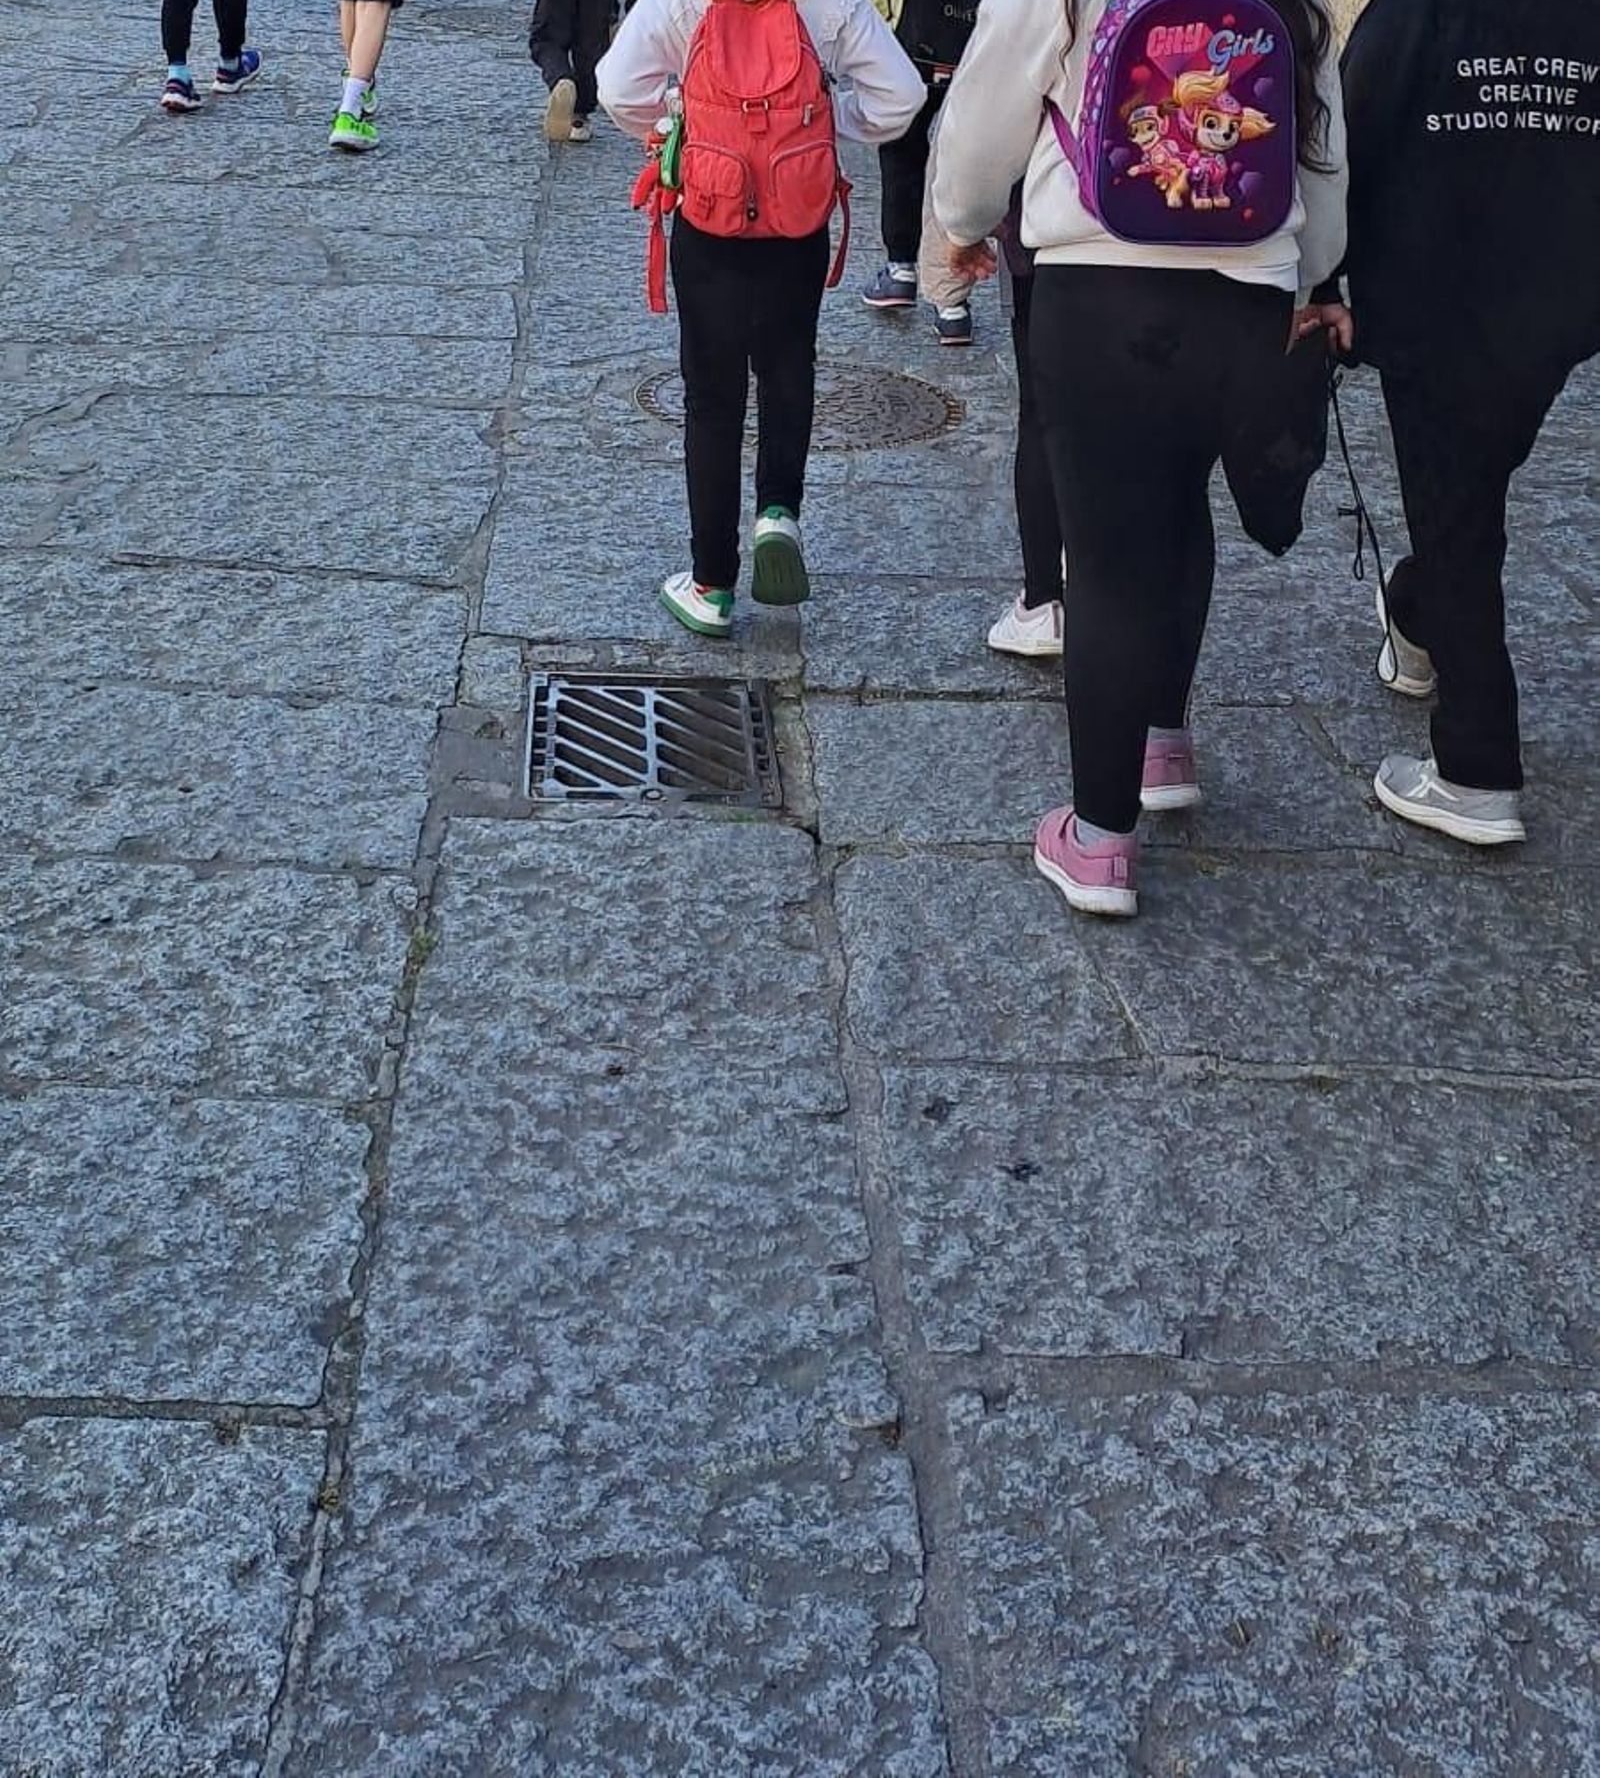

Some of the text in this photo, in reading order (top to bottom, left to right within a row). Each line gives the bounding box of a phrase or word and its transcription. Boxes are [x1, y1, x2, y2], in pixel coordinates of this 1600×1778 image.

[1207, 28, 1274, 74] Girls
[1457, 56, 1599, 83] GREAT CREW
[1479, 84, 1578, 105] CREATIVE
[1426, 111, 1508, 131] STUDIO
